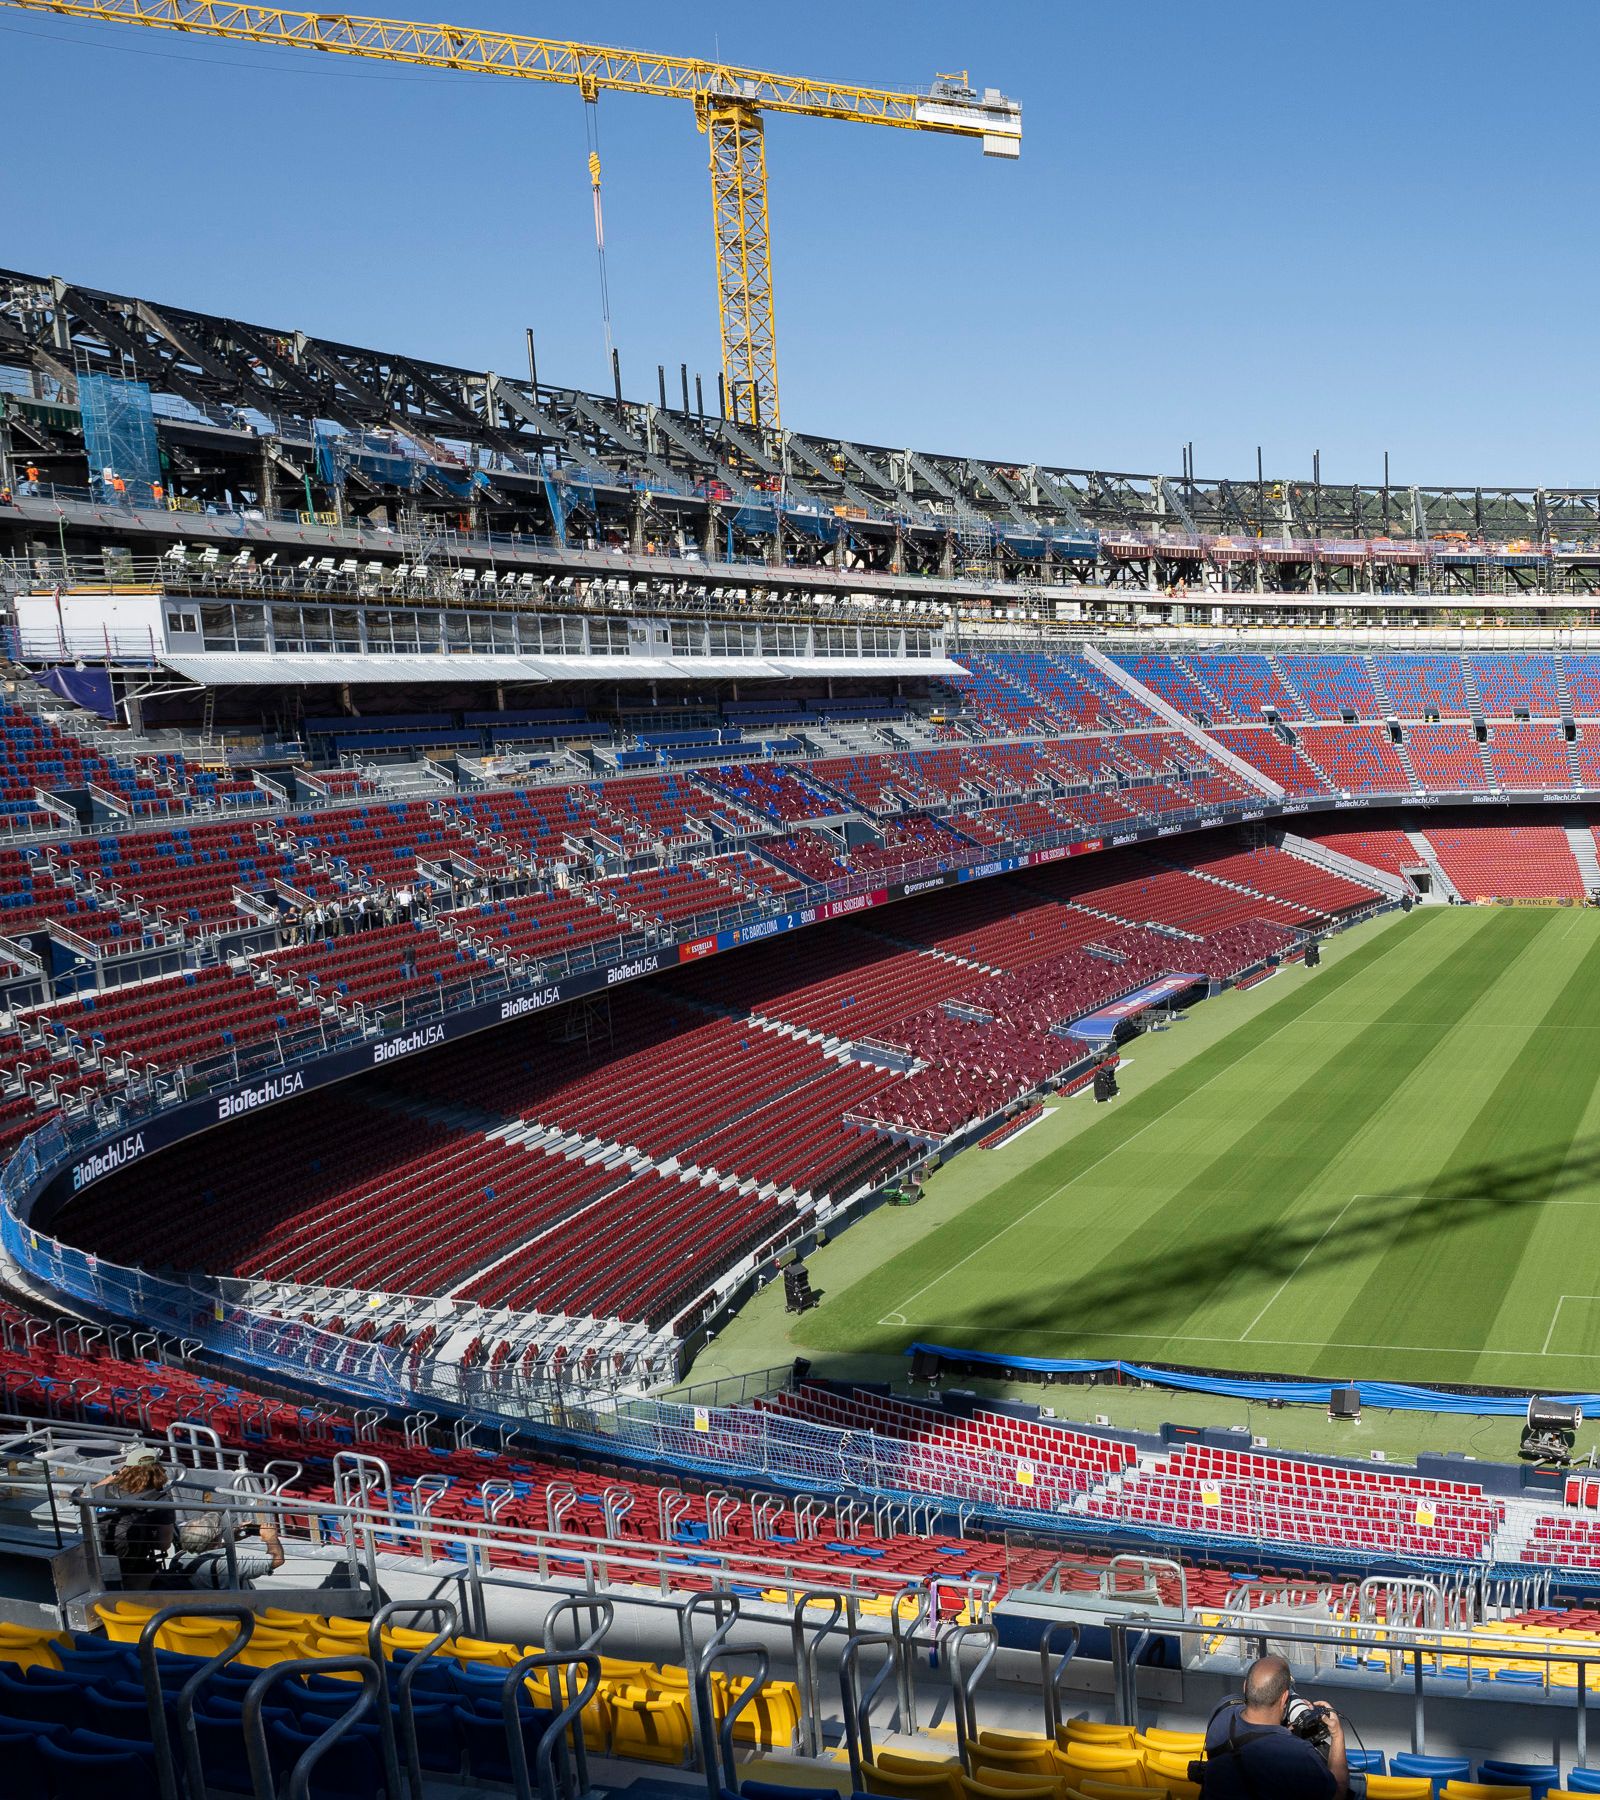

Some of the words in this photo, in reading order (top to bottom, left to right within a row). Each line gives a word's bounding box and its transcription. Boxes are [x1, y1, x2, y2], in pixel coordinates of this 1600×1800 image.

[742, 926, 749, 942] FC
[749, 919, 778, 939] BARCELONA
[787, 915, 793, 929] 2
[800, 908, 816, 924] 90:00
[824, 905, 829, 918] 1
[832, 899, 844, 913] REAL
[844, 895, 865, 911] SOCIEDAD
[1518, 899, 1552, 907] STANLEY
[607, 957, 659, 984] BioTechUSA
[501, 986, 560, 1020] BioTechUSA
[374, 1025, 445, 1063] BioTechUSA
[219, 1073, 304, 1119] BioTechUSA
[73, 1132, 145, 1190] BioTechUSA
